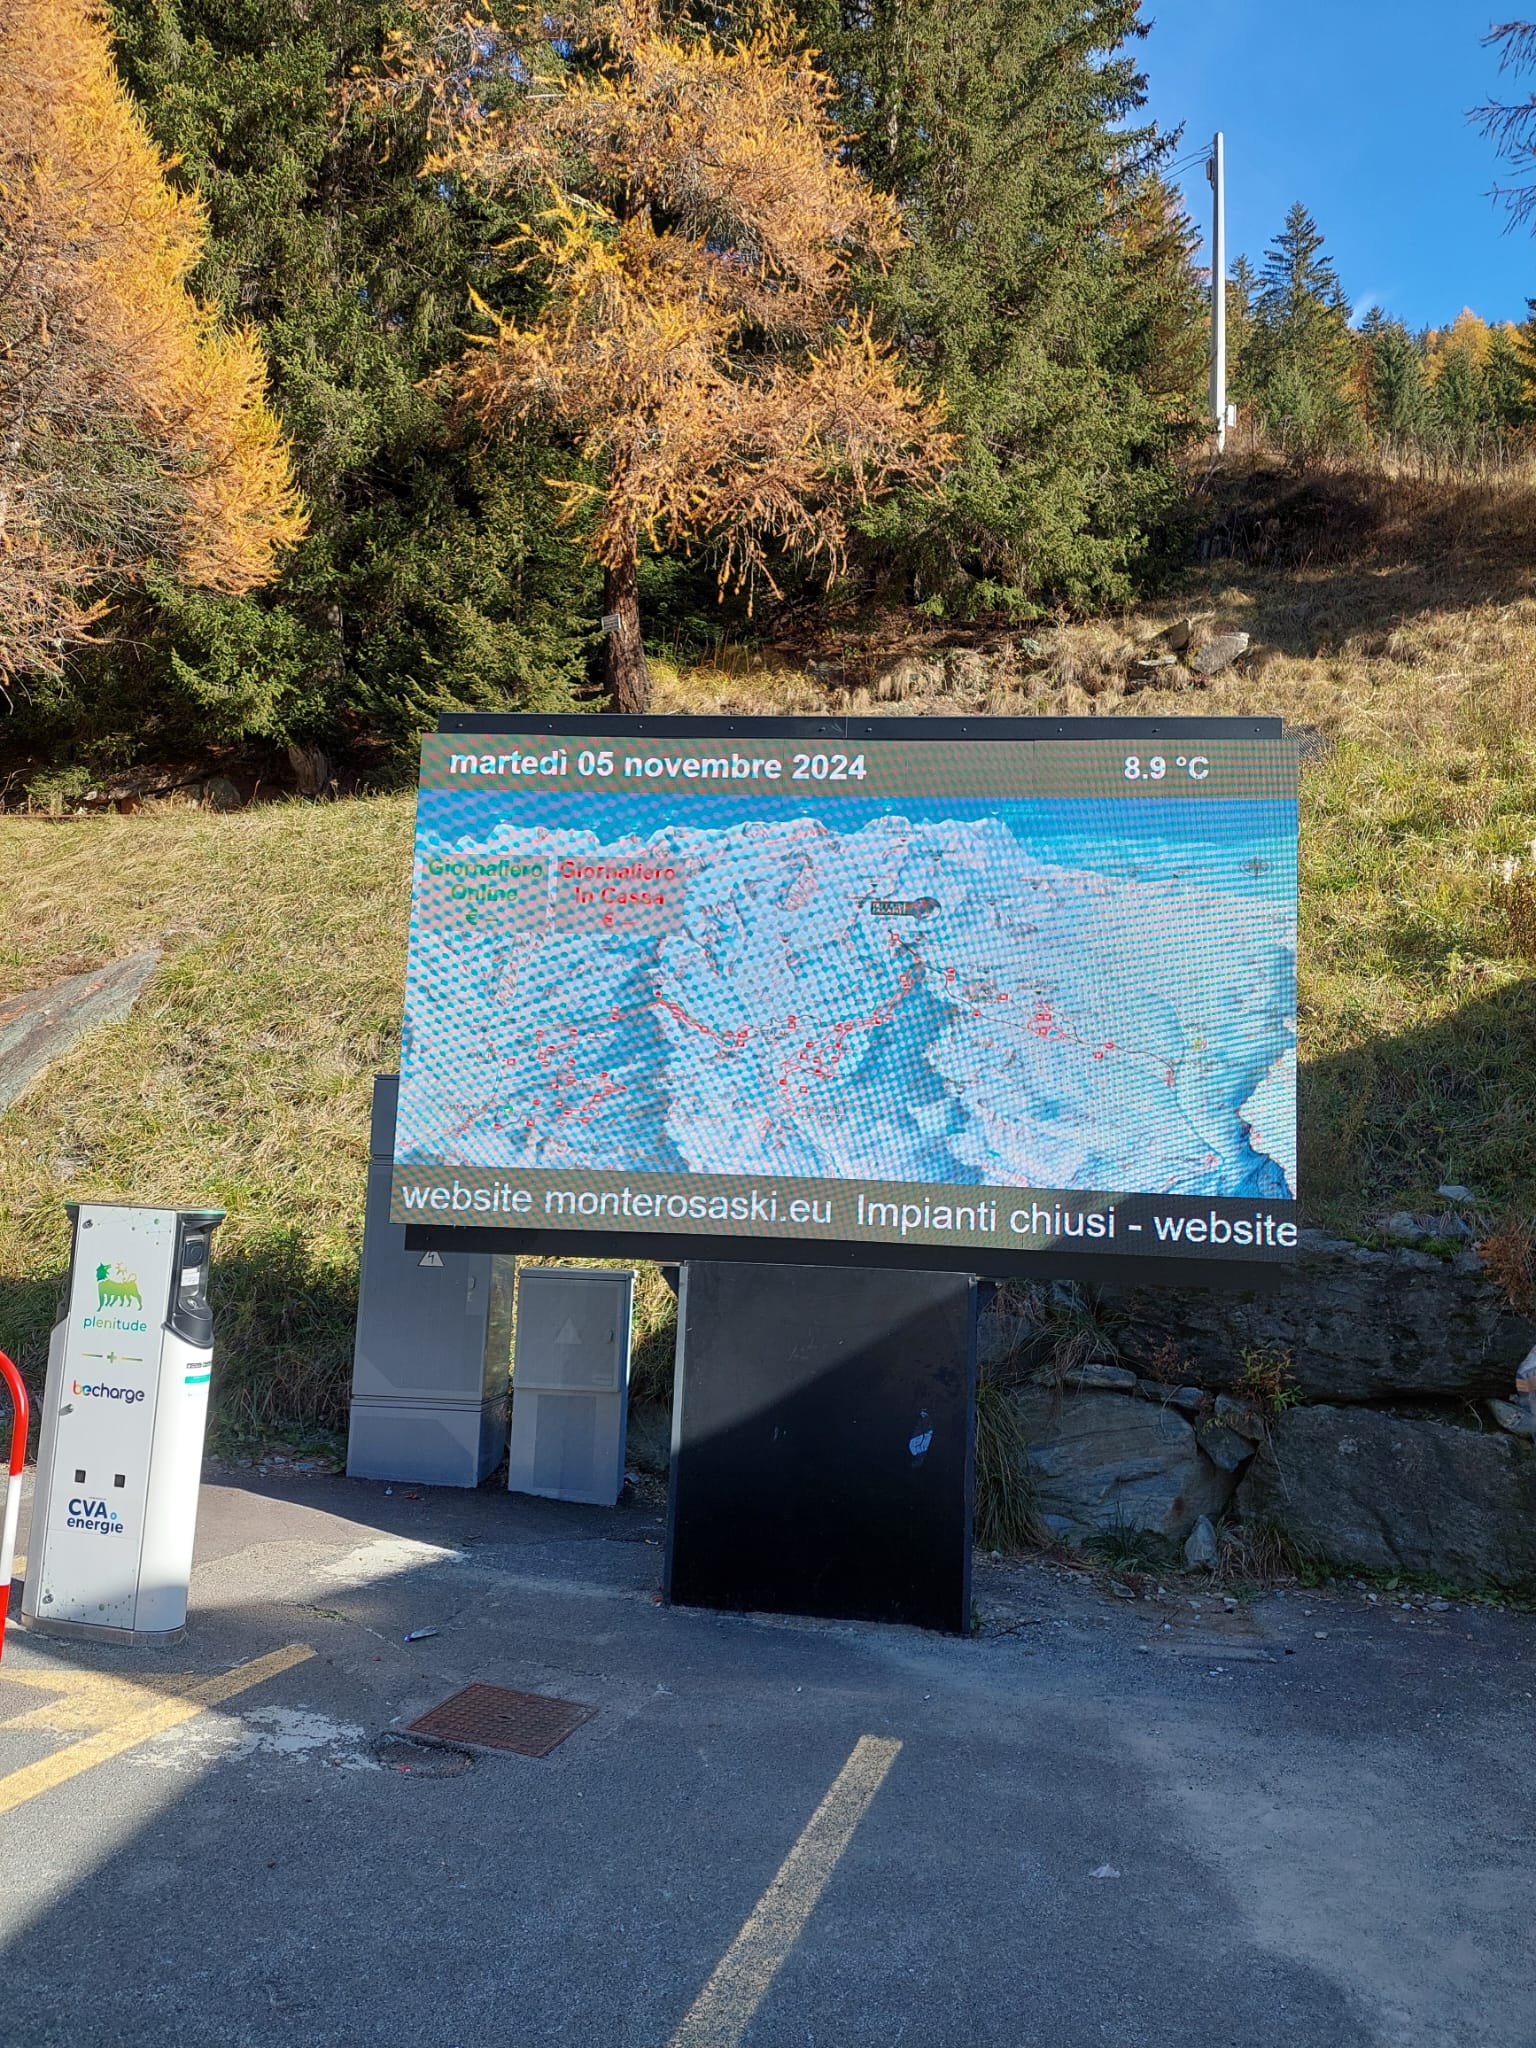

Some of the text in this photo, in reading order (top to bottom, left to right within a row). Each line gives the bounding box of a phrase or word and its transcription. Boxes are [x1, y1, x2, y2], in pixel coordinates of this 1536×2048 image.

[448, 749, 867, 781] martedì 05 novembre 2024
[1124, 756, 1209, 780] 8.9 °C
[428, 859, 543, 879] Giornaliero
[560, 861, 676, 882] Giornaliero
[451, 884, 518, 903] Online
[601, 887, 664, 906] Cassa
[402, 1180, 533, 1213] website
[544, 1184, 832, 1224] monterosaski.eu
[857, 1194, 996, 1235] Impianti
[1009, 1202, 1115, 1239] chiusi
[1153, 1210, 1298, 1247] website
[83, 1316, 147, 1332] plenitude
[72, 1380, 145, 1404] becharge
[68, 1498, 108, 1519] CVA
[66, 1517, 124, 1535] energie
